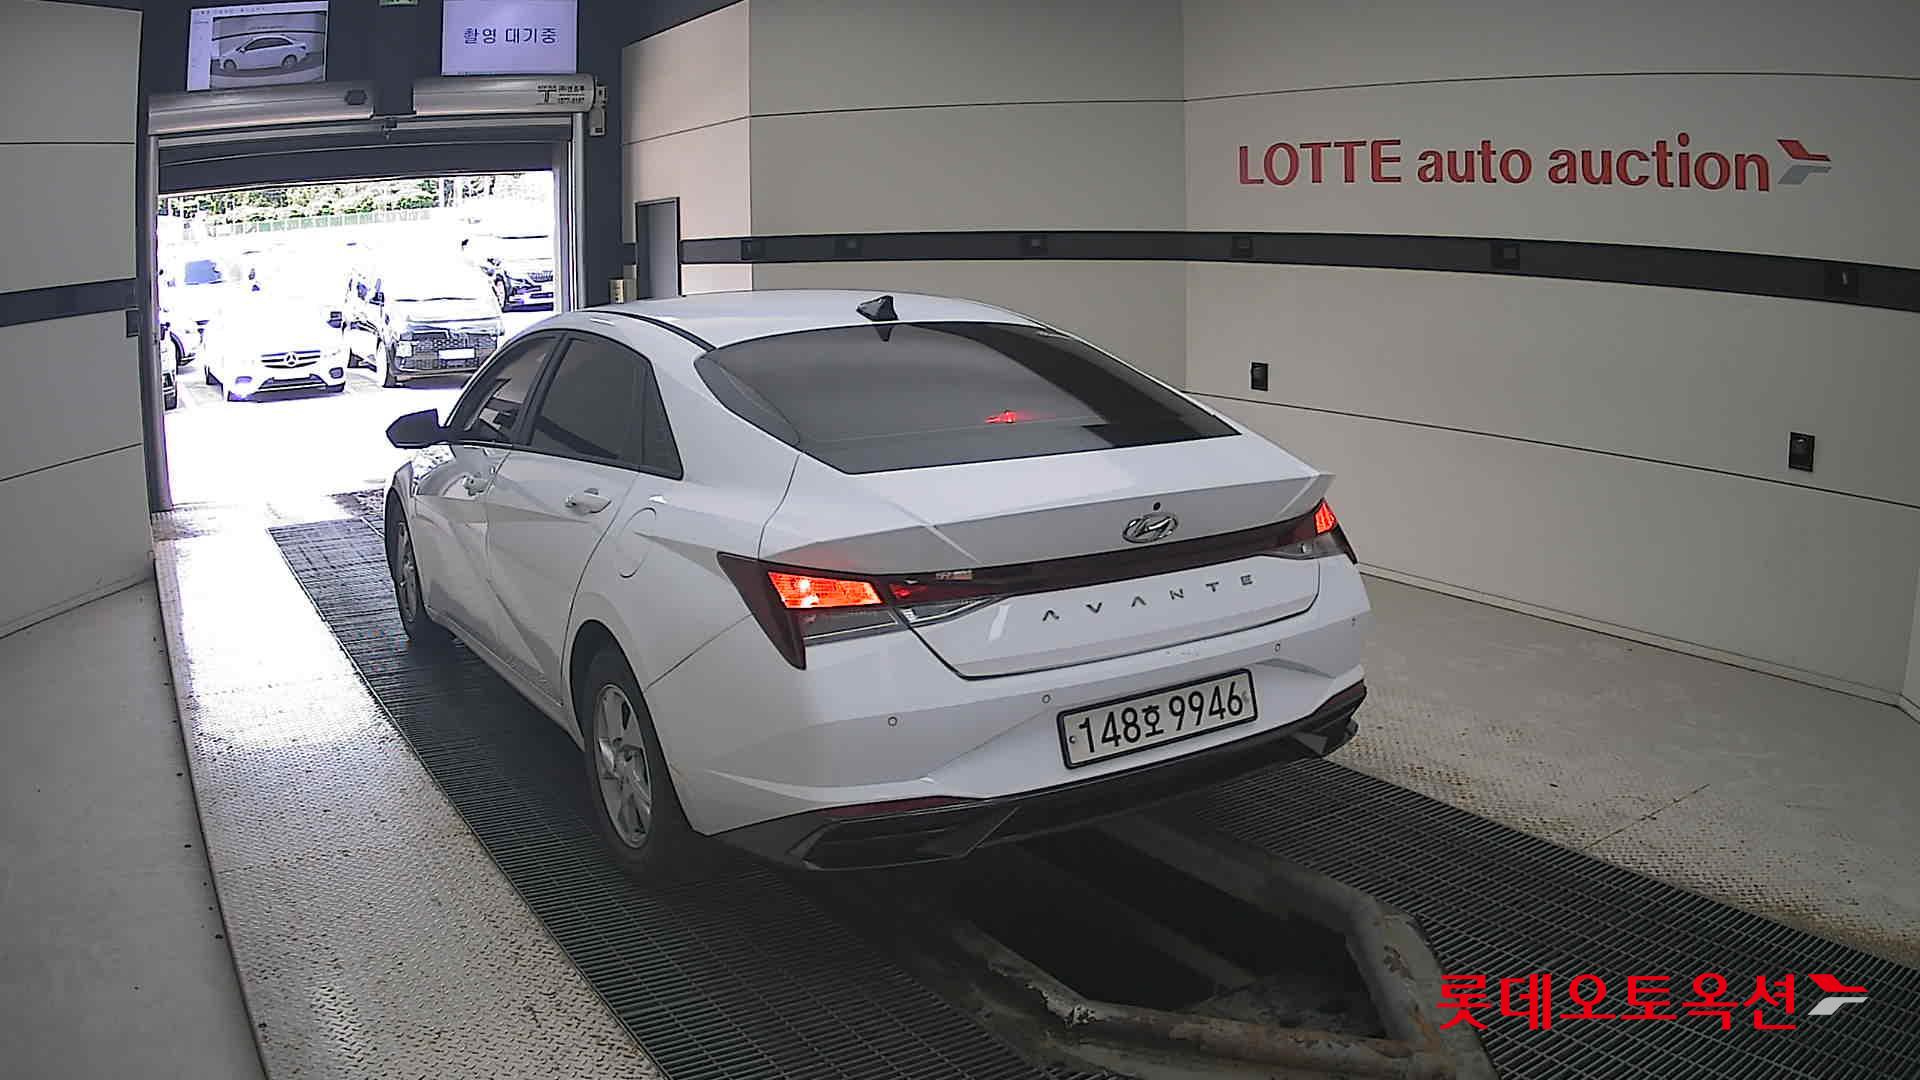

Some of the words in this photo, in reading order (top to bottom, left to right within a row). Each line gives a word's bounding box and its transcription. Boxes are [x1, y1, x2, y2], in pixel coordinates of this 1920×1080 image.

[464, 28, 496, 44] 촬영
[505, 28, 556, 44] 대기중
[1239, 139, 1401, 186] LOTTE
[1416, 140, 1533, 184] auto
[1547, 132, 1770, 192] auction
[1042, 574, 1253, 622] AVANTE
[1078, 705, 1164, 753] 148호
[1169, 681, 1243, 731] 9946
